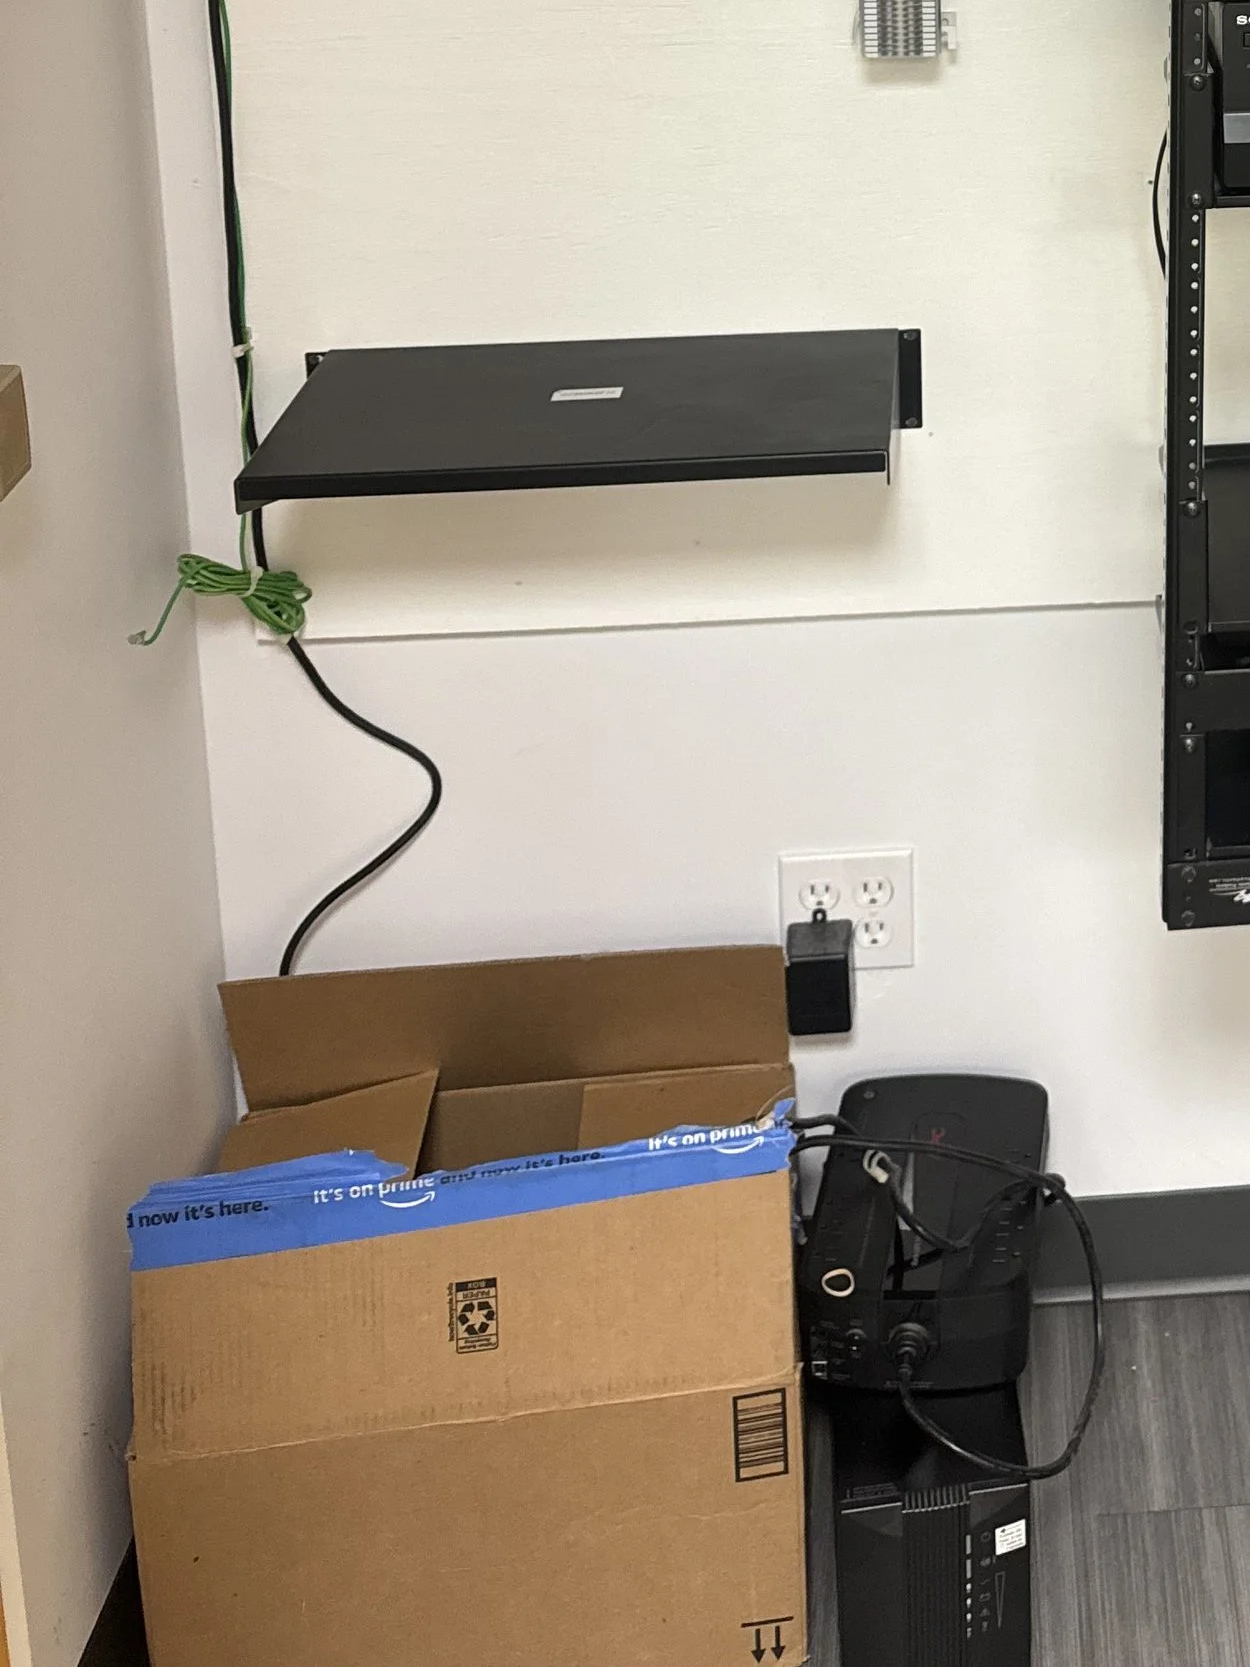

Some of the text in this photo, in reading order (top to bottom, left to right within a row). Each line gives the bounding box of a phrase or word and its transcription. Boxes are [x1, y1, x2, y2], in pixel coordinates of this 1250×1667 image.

[649, 1138, 677, 1152] It's
[682, 1133, 706, 1145] on
[313, 1188, 343, 1204] It's
[349, 1183, 374, 1199] on
[138, 1211, 180, 1228] now
[184, 1204, 214, 1222] it's
[219, 1199, 269, 1218] here.
